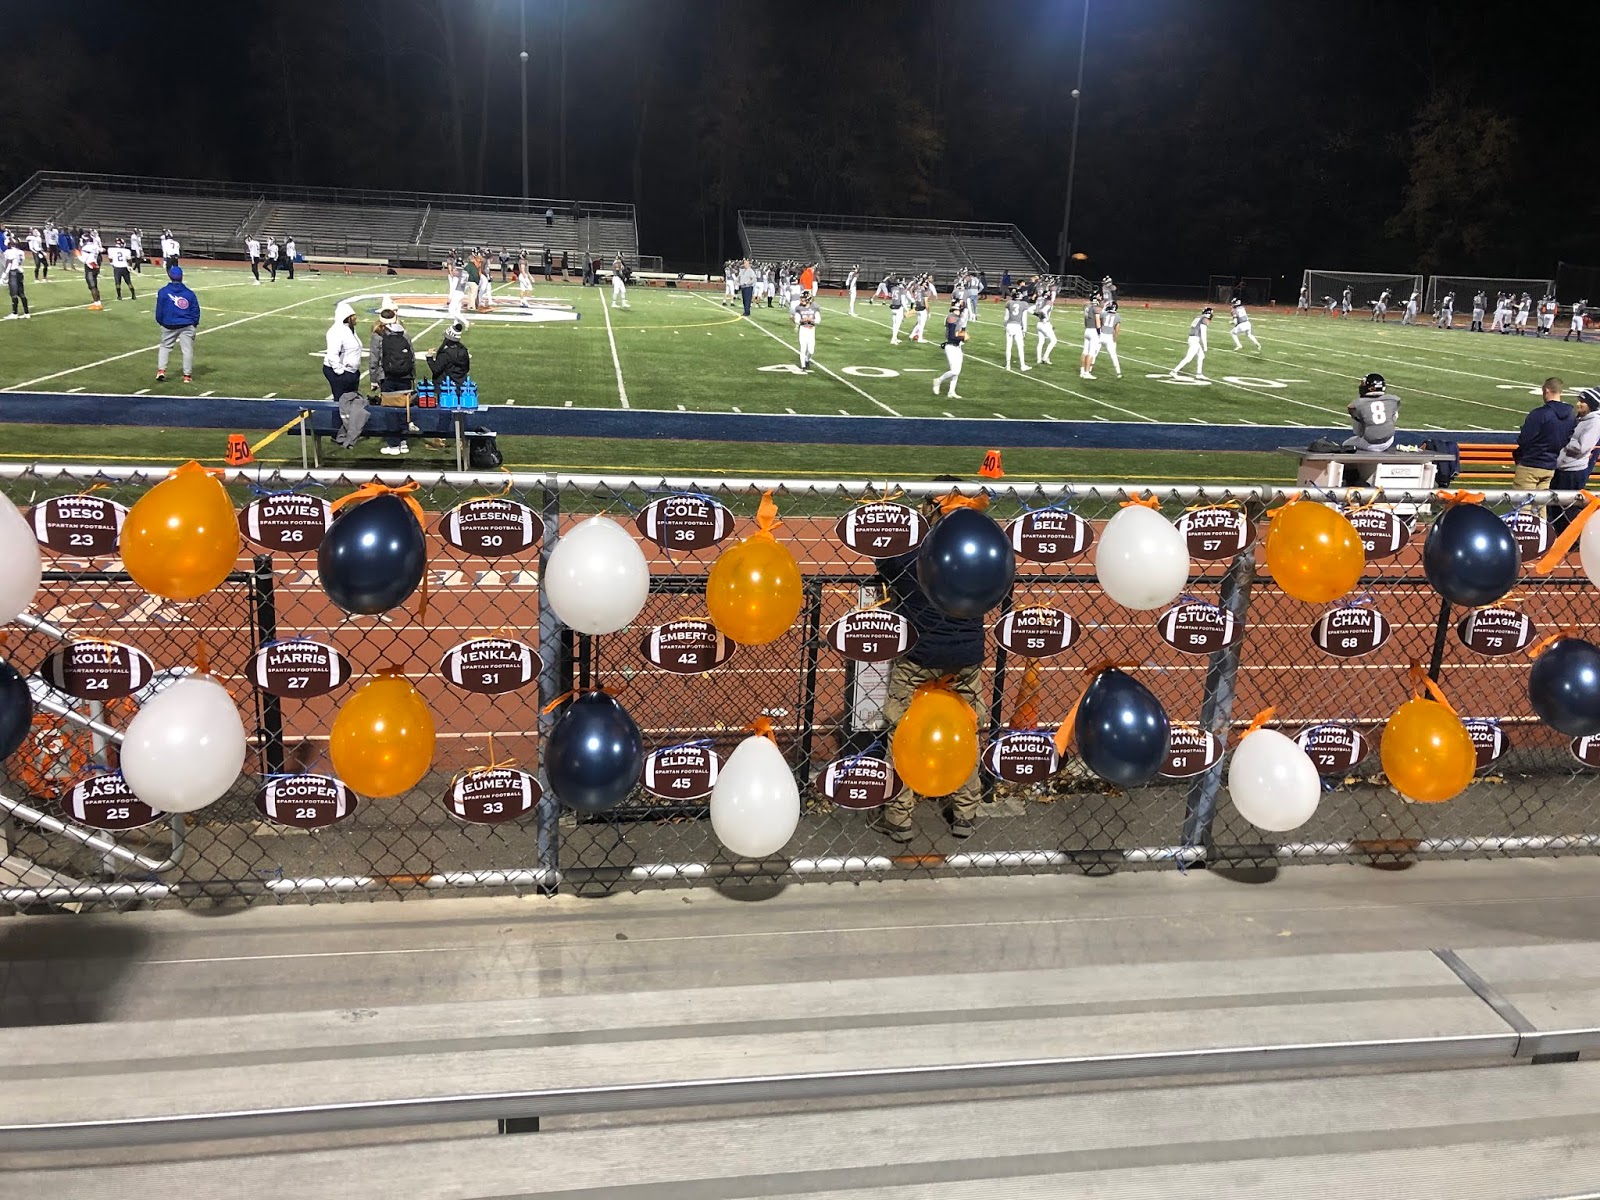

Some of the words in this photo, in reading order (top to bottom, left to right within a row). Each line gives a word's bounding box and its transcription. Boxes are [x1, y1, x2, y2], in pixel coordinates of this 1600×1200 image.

[1370, 400, 1387, 425] 8
[234, 441, 249, 461] 50
[983, 455, 995, 472] 40
[58, 508, 104, 520] DESO
[263, 505, 320, 517] DAVIES
[664, 506, 709, 518] COLE
[459, 512, 526, 524] ECLESENBE
[854, 512, 914, 525] YSEWY
[1033, 520, 1066, 531] BELL
[1185, 517, 1241, 531] DRAPER
[1350, 519, 1387, 530] BRICE
[70, 534, 94, 546] 23
[281, 530, 303, 541] 26
[675, 530, 695, 540] 36
[481, 536, 502, 546] 30
[872, 537, 892, 547] 47
[1203, 540, 1221, 551] 57
[1038, 543, 1056, 553] 53
[1178, 612, 1226, 625] STUCK
[1332, 616, 1371, 627] CHAN
[1473, 618, 1522, 629] ALLAGHE
[660, 632, 717, 643] EMBERTO
[1027, 638, 1045, 648] 55
[1189, 634, 1207, 645] 59
[1341, 638, 1358, 648] 68
[1486, 637, 1502, 647] 75
[862, 643, 877, 653] 51
[72, 653, 122, 665] KOLVA
[269, 653, 327, 665] HARRIS
[678, 653, 697, 664] 42
[288, 677, 309, 688] 27
[482, 673, 499, 684] 31
[86, 679, 109, 690] 24
[1001, 743, 1052, 755] RAUGUT
[661, 756, 705, 767] ELDER
[1172, 757, 1187, 767] 61
[1319, 755, 1335, 765] 72
[1015, 765, 1033, 774] 56
[463, 779, 523, 794] EUMEYE
[672, 778, 691, 789] 45
[276, 786, 337, 798] COOPER
[849, 789, 867, 799] 52
[107, 808, 130, 819] 25
[296, 808, 316, 819] 28
[483, 802, 503, 814] 33
